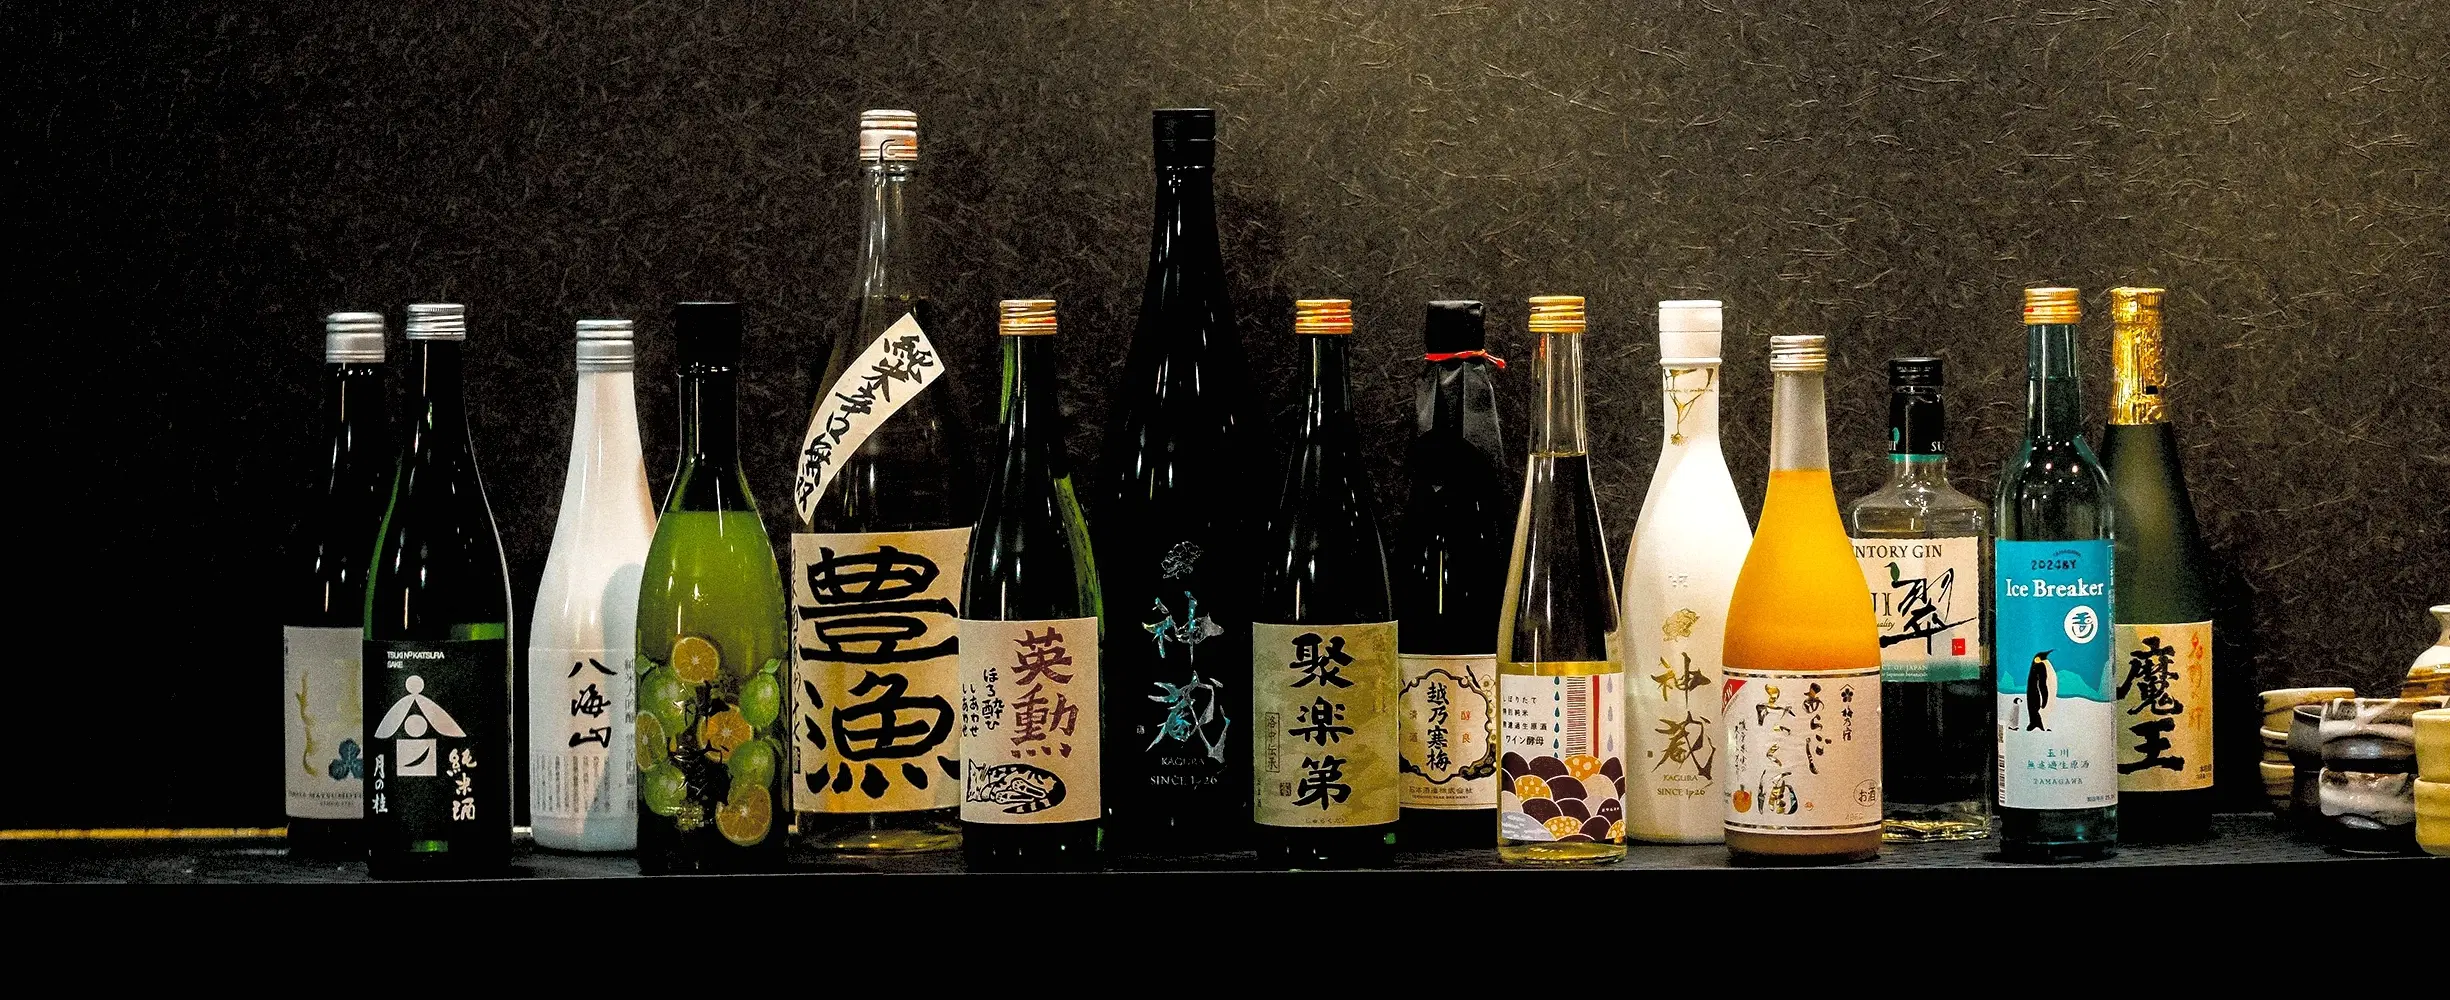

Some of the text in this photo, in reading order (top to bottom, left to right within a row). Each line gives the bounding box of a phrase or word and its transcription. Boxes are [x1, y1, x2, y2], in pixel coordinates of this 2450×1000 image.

[1853, 544, 1943, 559] NTORY GIN
[2005, 577, 2104, 597] Ice Breaker
[387, 660, 403, 669] SAKE
[797, 545, 960, 799] 豊漁
[567, 658, 617, 749] 八海山
[969, 683, 980, 738] しあわせ
[1288, 632, 1357, 811] 聚楽第
[1426, 681, 1452, 772] 越乃寒梅
[1802, 682, 1832, 775] あらごし
[2116, 636, 2185, 774] 魔王
[1505, 735, 1545, 747] ワイン酵母
[371, 754, 388, 815] 月の桂
[446, 748, 478, 821] 純米酒
[1150, 775, 1187, 786] SINCE
[1656, 787, 1684, 796] SINCE
[1858, 786, 1876, 802] お酒
